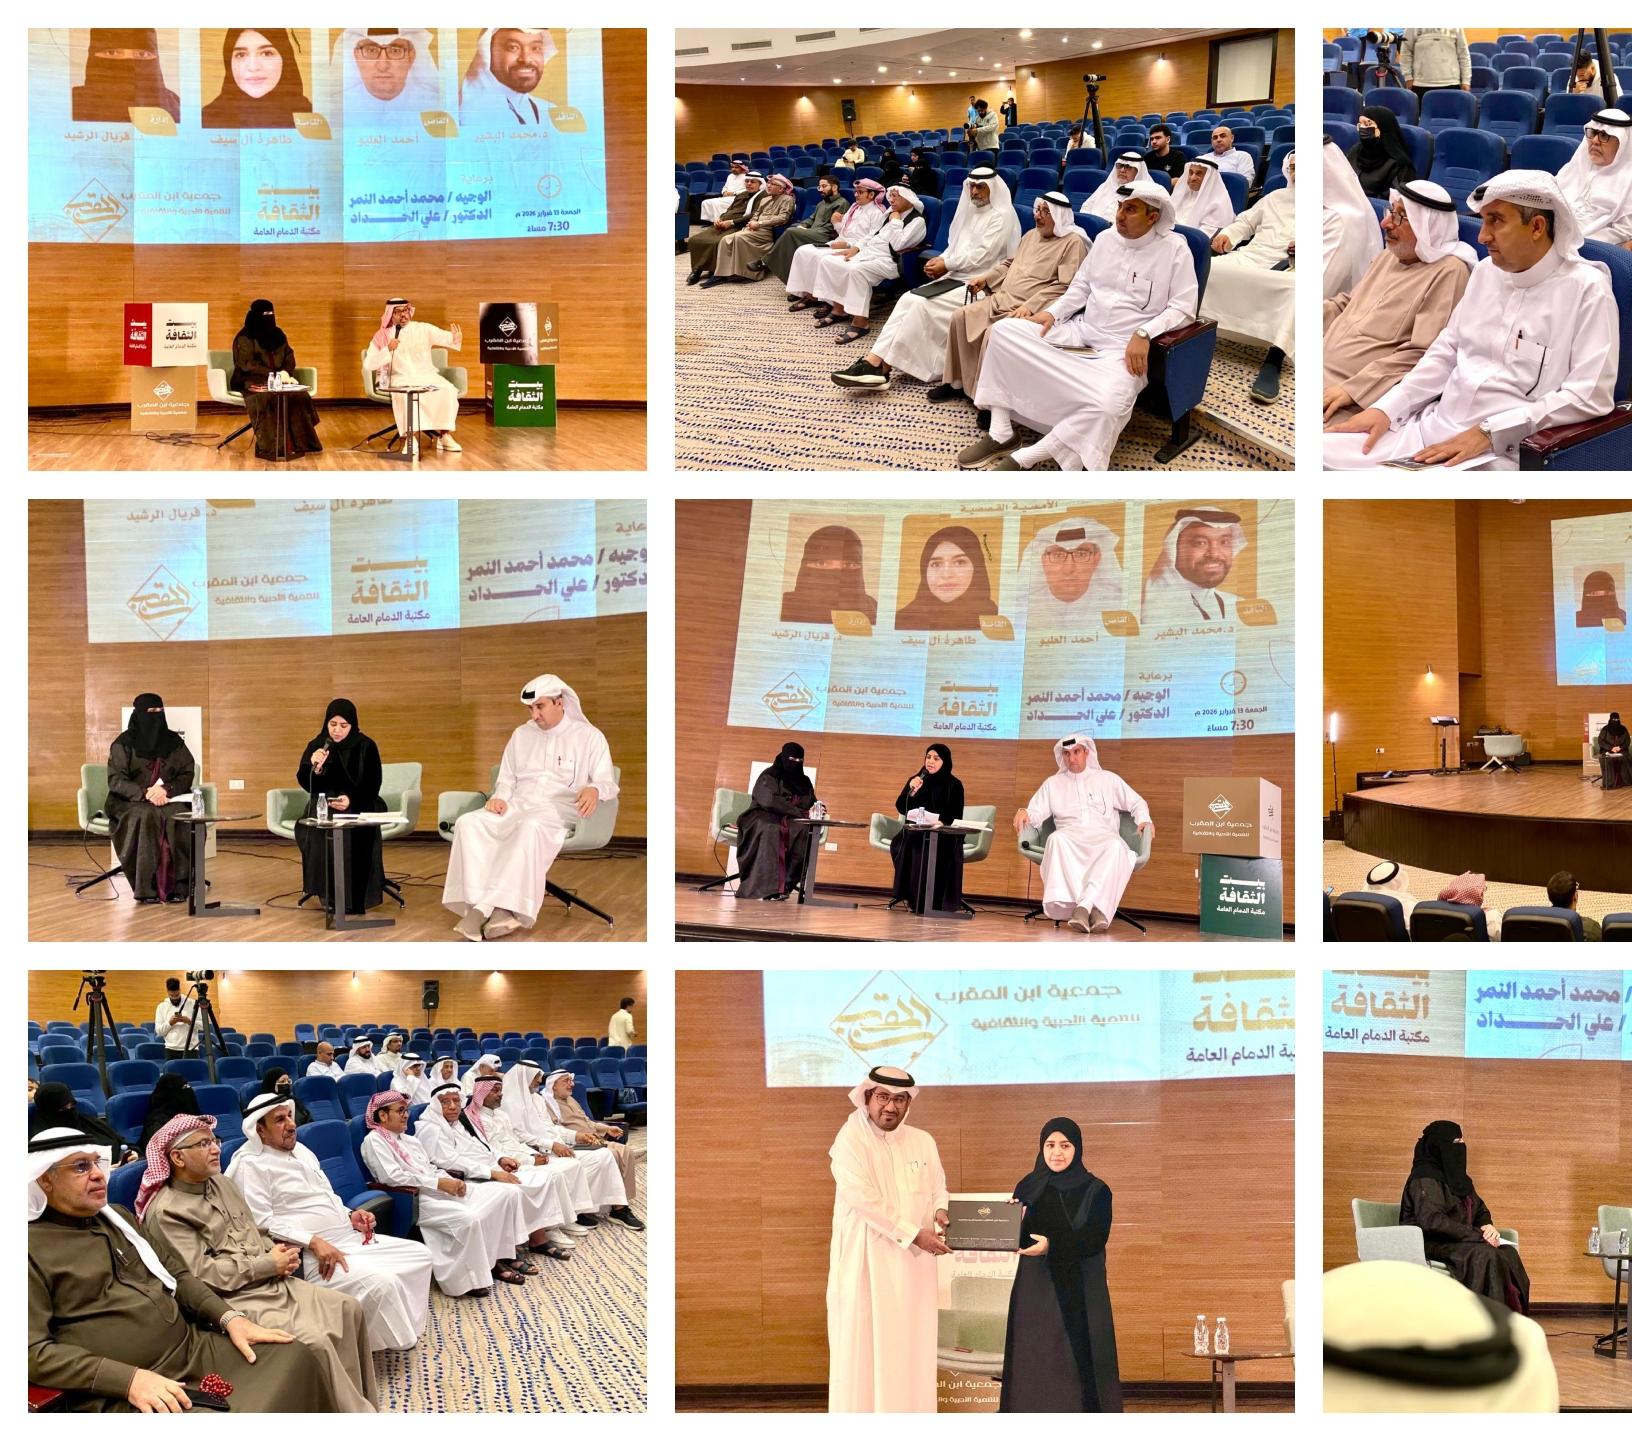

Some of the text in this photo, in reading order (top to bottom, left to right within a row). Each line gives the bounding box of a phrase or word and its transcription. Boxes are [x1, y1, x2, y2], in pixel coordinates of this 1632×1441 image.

[350, 193, 377, 209] النمر
[378, 189, 409, 206] أحمد
[410, 192, 445, 206] محمد
[456, 190, 493, 204] الوجيه
[420, 210, 442, 229] علي
[452, 209, 493, 226] الدكتور
[548, 220, 571, 233] 7:30
[508, 389, 544, 402] الثقافة
[126, 507, 201, 525] فريال الرشيد
[293, 500, 327, 516] سيف
[504, 550, 544, 574] أحمد
[547, 552, 595, 571] محمد
[466, 558, 502, 582] النمر
[263, 574, 309, 588] جمعية
[351, 578, 429, 606] الثقافة
[562, 576, 589, 604] علي
[347, 611, 431, 627] مكتبة الدمام العامة
[901, 632, 977, 647] طاهرة سيف
[1071, 633, 1100, 646] أحمد
[1154, 627, 1187, 641] البشير
[870, 685, 907, 697] جمعية
[1026, 690, 1053, 706] النمر
[1054, 687, 1084, 703] أحمد
[1086, 691, 1122, 703] محمد
[1132, 687, 1170, 704] الوجيه
[937, 696, 998, 717] الثقافة
[1127, 706, 1170, 723] الدكتور
[1218, 708, 1236, 717] فبراير
[1244, 705, 1268, 714] الجمعة
[1096, 708, 1117, 727] علي
[1230, 719, 1254, 731] 7:30
[933, 721, 997, 733] مكتبة الدمام العامة
[1219, 875, 1266, 890] بيت
[1219, 886, 1266, 905] الثقافة
[1216, 904, 1266, 916] مكتبة الدمام العامة
[935, 983, 1122, 1004] جمعية ابن المقرب
[1474, 981, 1517, 1004] النمر
[1520, 978, 1566, 1002] أحمد
[1569, 986, 1622, 1004] محمد
[1331, 983, 1430, 1020] الثقافة
[971, 1016, 1039, 1031] والثقافية
[1584, 1012, 1615, 1041] علي
[1324, 1026, 1430, 1045] مكتبة الدمام العامة
[1186, 1047, 1228, 1062] العامة
[1231, 1045, 1275, 1066] الدمام
[948, 1380, 963, 1390] ابن
[964, 1380, 1002, 1390] جمعية
